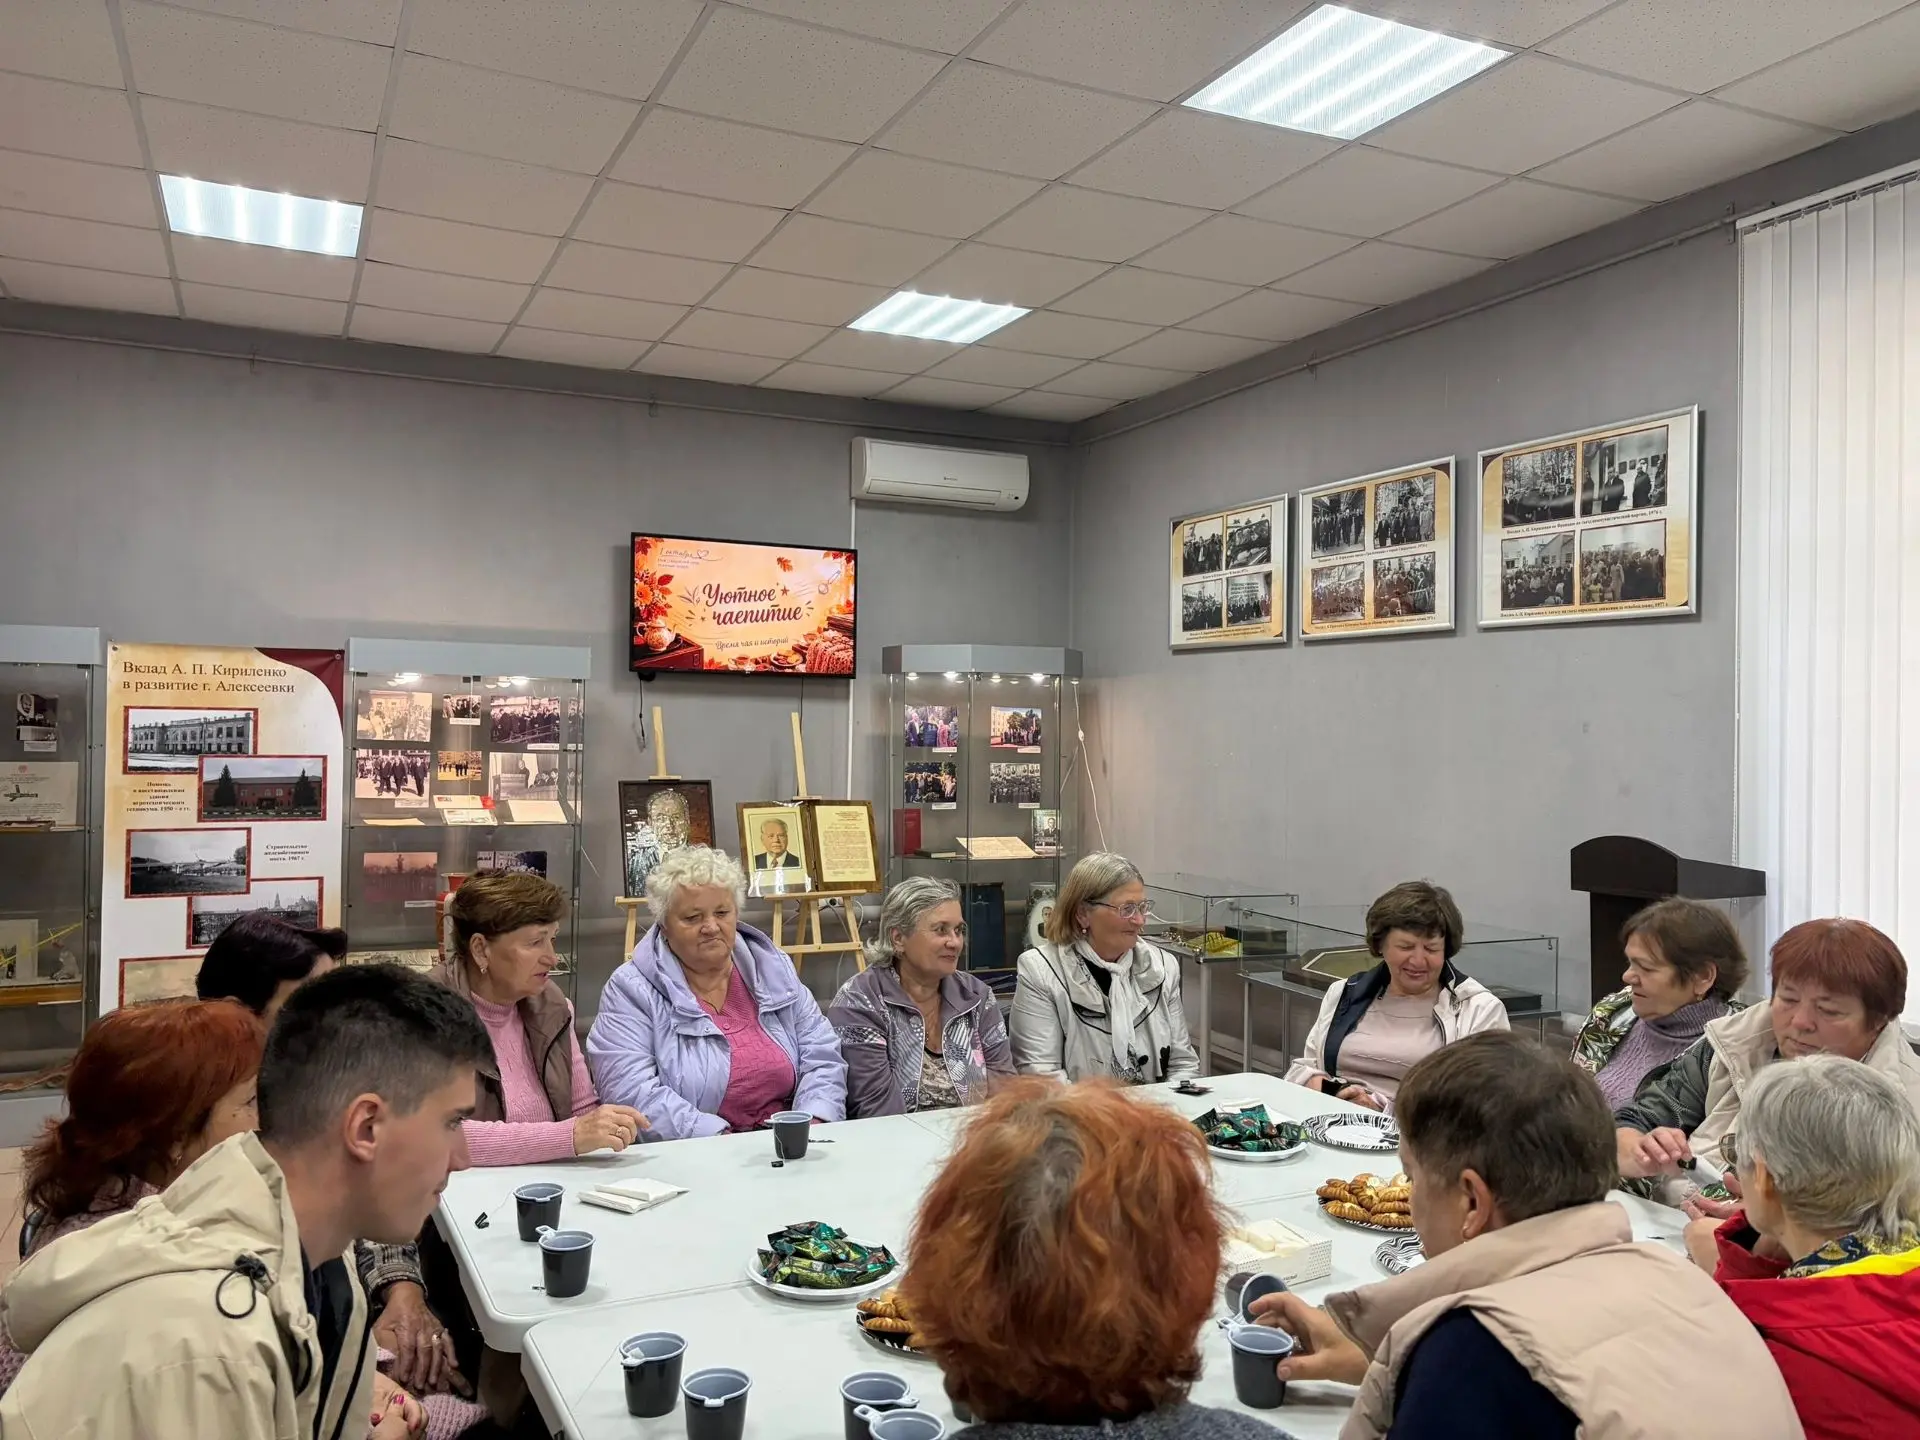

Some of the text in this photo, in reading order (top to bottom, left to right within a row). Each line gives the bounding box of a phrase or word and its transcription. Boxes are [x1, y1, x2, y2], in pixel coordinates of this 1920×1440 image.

[702, 583, 776, 607] Уютное
[712, 604, 804, 626] чаепитие
[716, 640, 740, 652] Время
[760, 636, 789, 647] историй
[122, 662, 287, 678] Вклад А. П. Кириленко
[122, 680, 295, 693] в развитие г. Алексеевки
